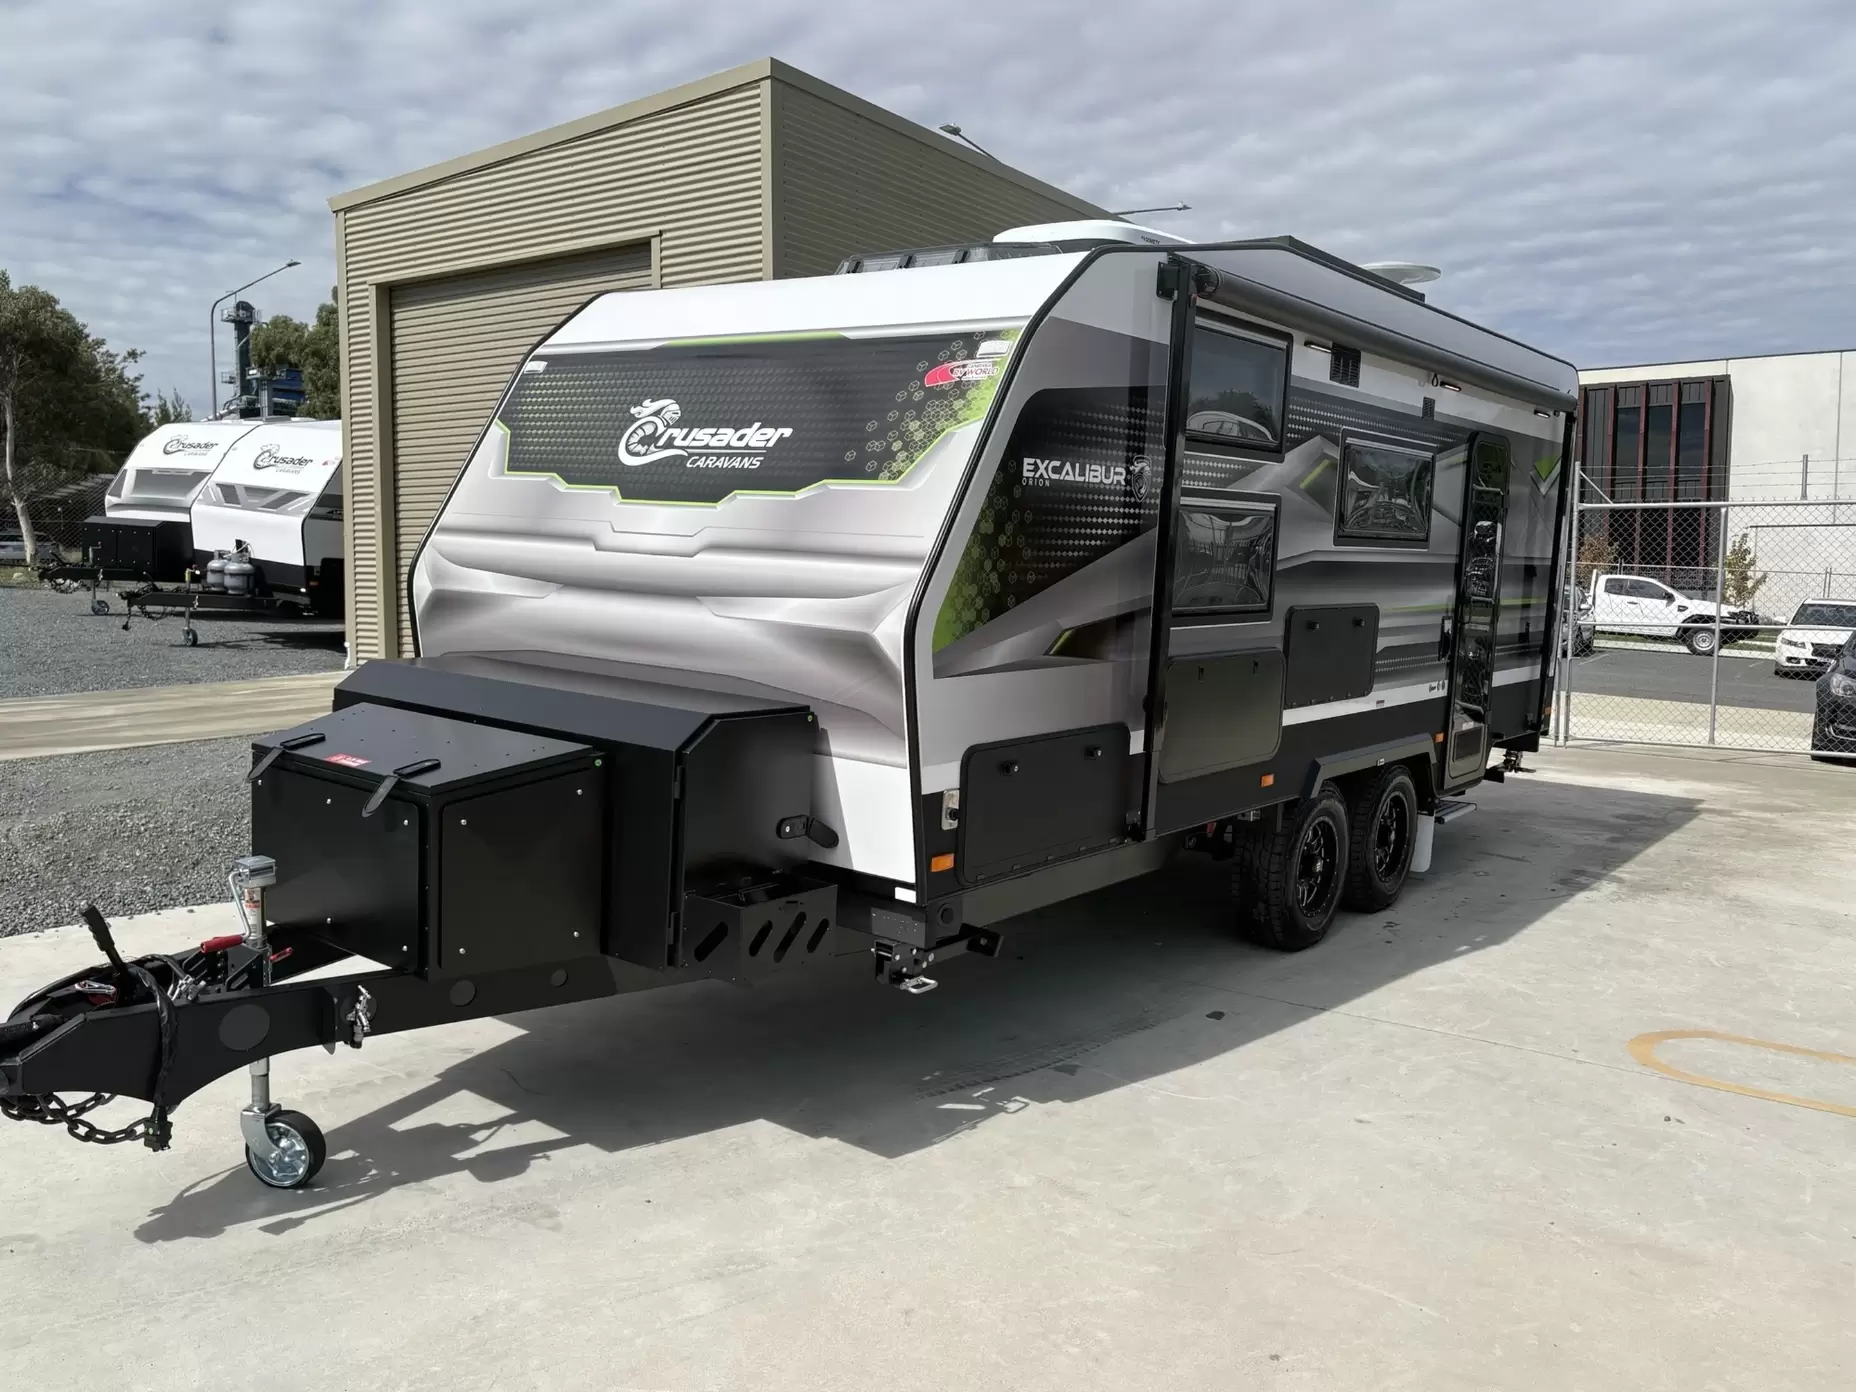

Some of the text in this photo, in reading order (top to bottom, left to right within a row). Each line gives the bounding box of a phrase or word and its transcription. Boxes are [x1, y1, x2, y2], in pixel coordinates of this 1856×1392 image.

[953, 366, 999, 377] RV WORLD
[162, 438, 219, 456] Crusader
[617, 414, 794, 467] Crusader
[252, 448, 314, 471] Crusader
[685, 455, 765, 470] CARAVANS
[1022, 457, 1126, 486] EXCALIBUR
[1021, 477, 1051, 488] ORION
